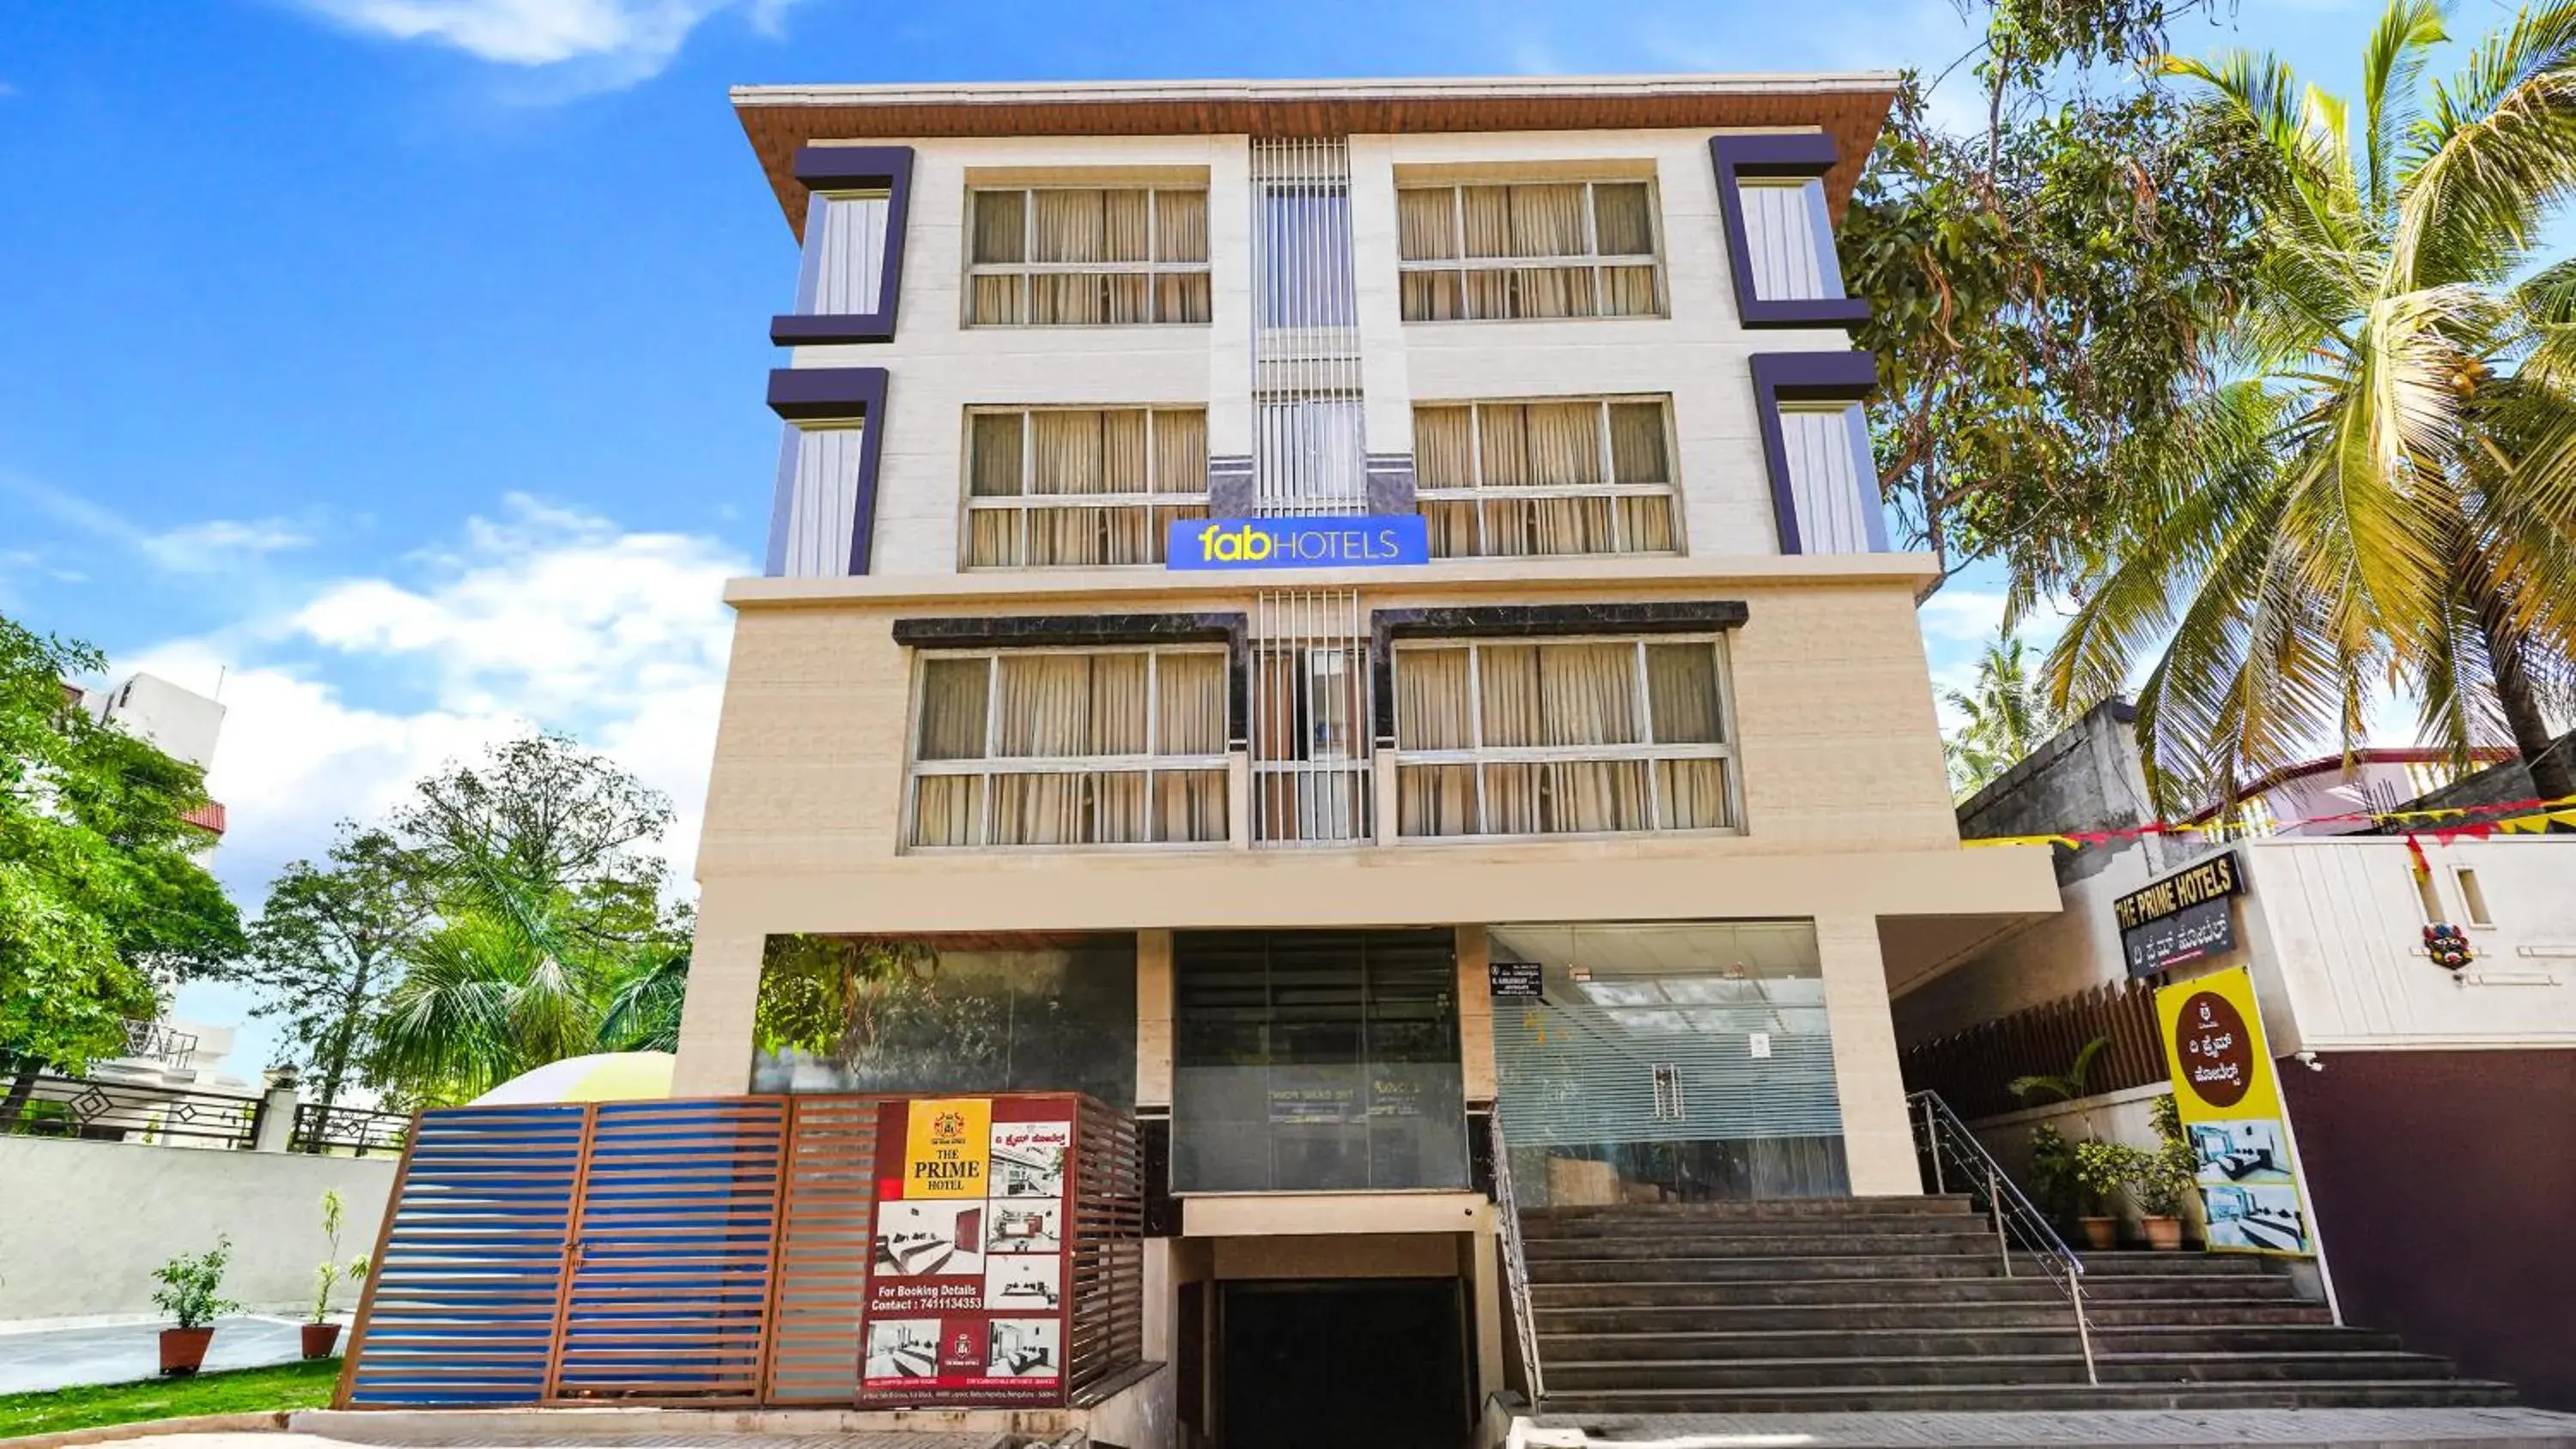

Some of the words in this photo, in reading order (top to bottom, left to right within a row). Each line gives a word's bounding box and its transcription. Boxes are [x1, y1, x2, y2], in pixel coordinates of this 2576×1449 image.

[2115, 898, 2137, 928] THE
[2136, 882, 2177, 923] PRIME
[2175, 858, 2232, 907] HOTELS
[937, 1150, 959, 1160] THE
[914, 1161, 981, 1179] PRIME
[927, 1180, 964, 1191] HOTEL
[878, 1286, 896, 1297] For
[897, 1284, 939, 1298] Booking
[941, 1284, 976, 1295] Details
[872, 1300, 912, 1311] Contact
